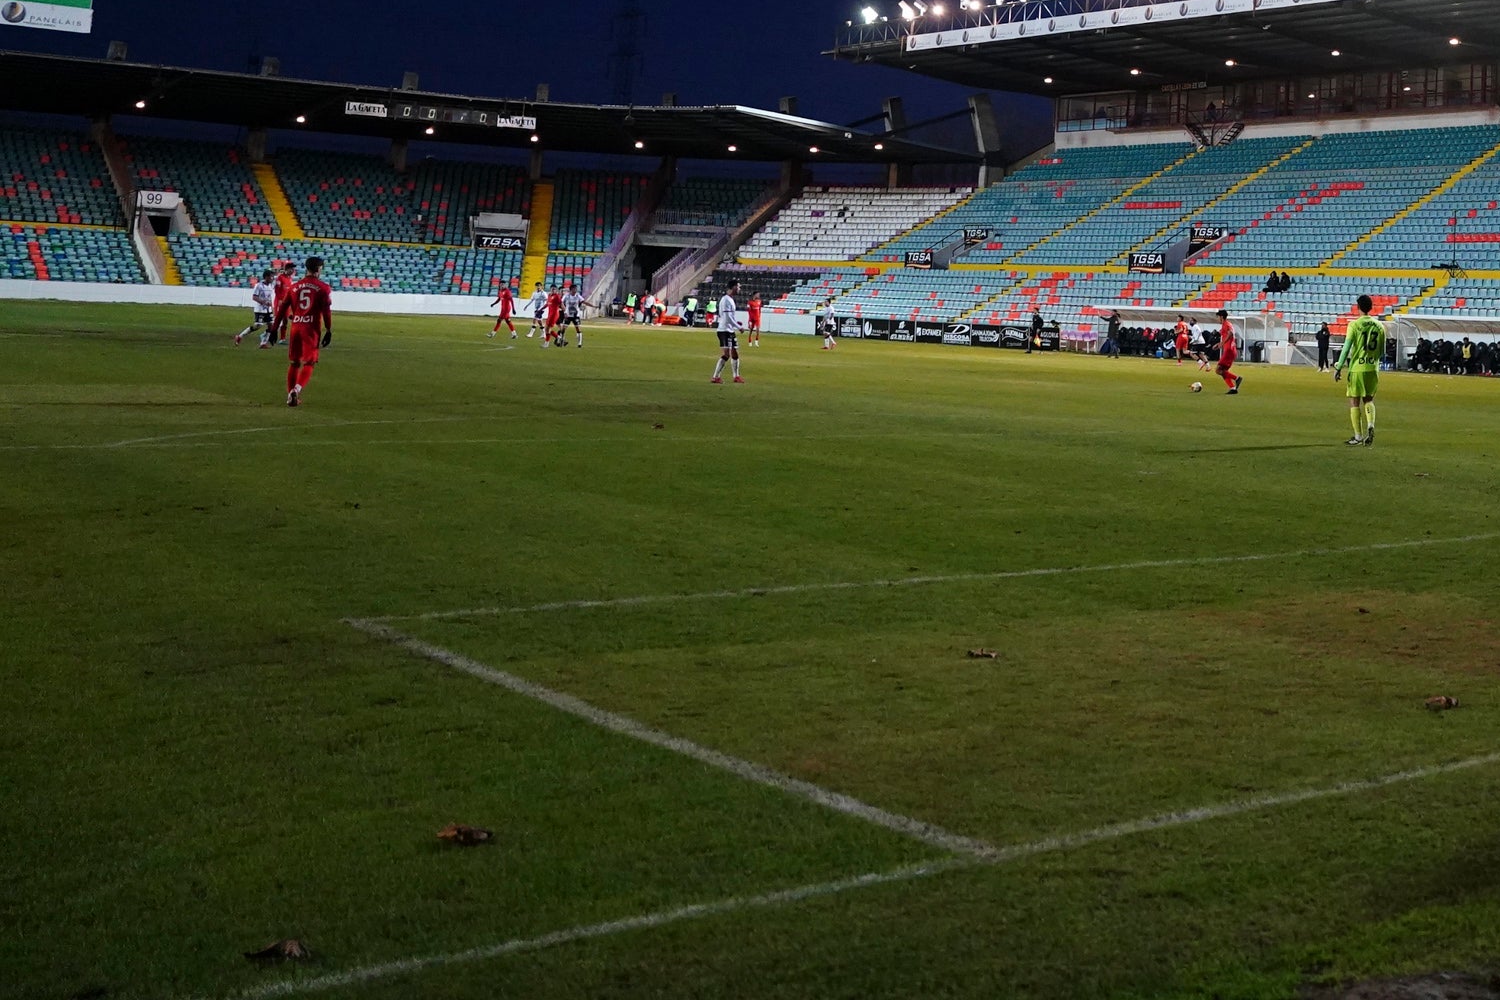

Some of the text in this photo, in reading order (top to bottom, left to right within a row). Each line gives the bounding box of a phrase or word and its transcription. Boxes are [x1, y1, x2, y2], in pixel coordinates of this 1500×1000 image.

[30, 16, 82, 27] PANELAIS
[147, 193, 162, 204] 99
[966, 229, 987, 237] TGSA
[1194, 228, 1220, 236] TGSA
[482, 237, 522, 247] TGSA
[908, 253, 931, 261] TGSA
[1132, 254, 1163, 264] TGSA
[299, 289, 311, 310] 5
[293, 315, 314, 323] DIGI
[1361, 330, 1379, 351] 13
